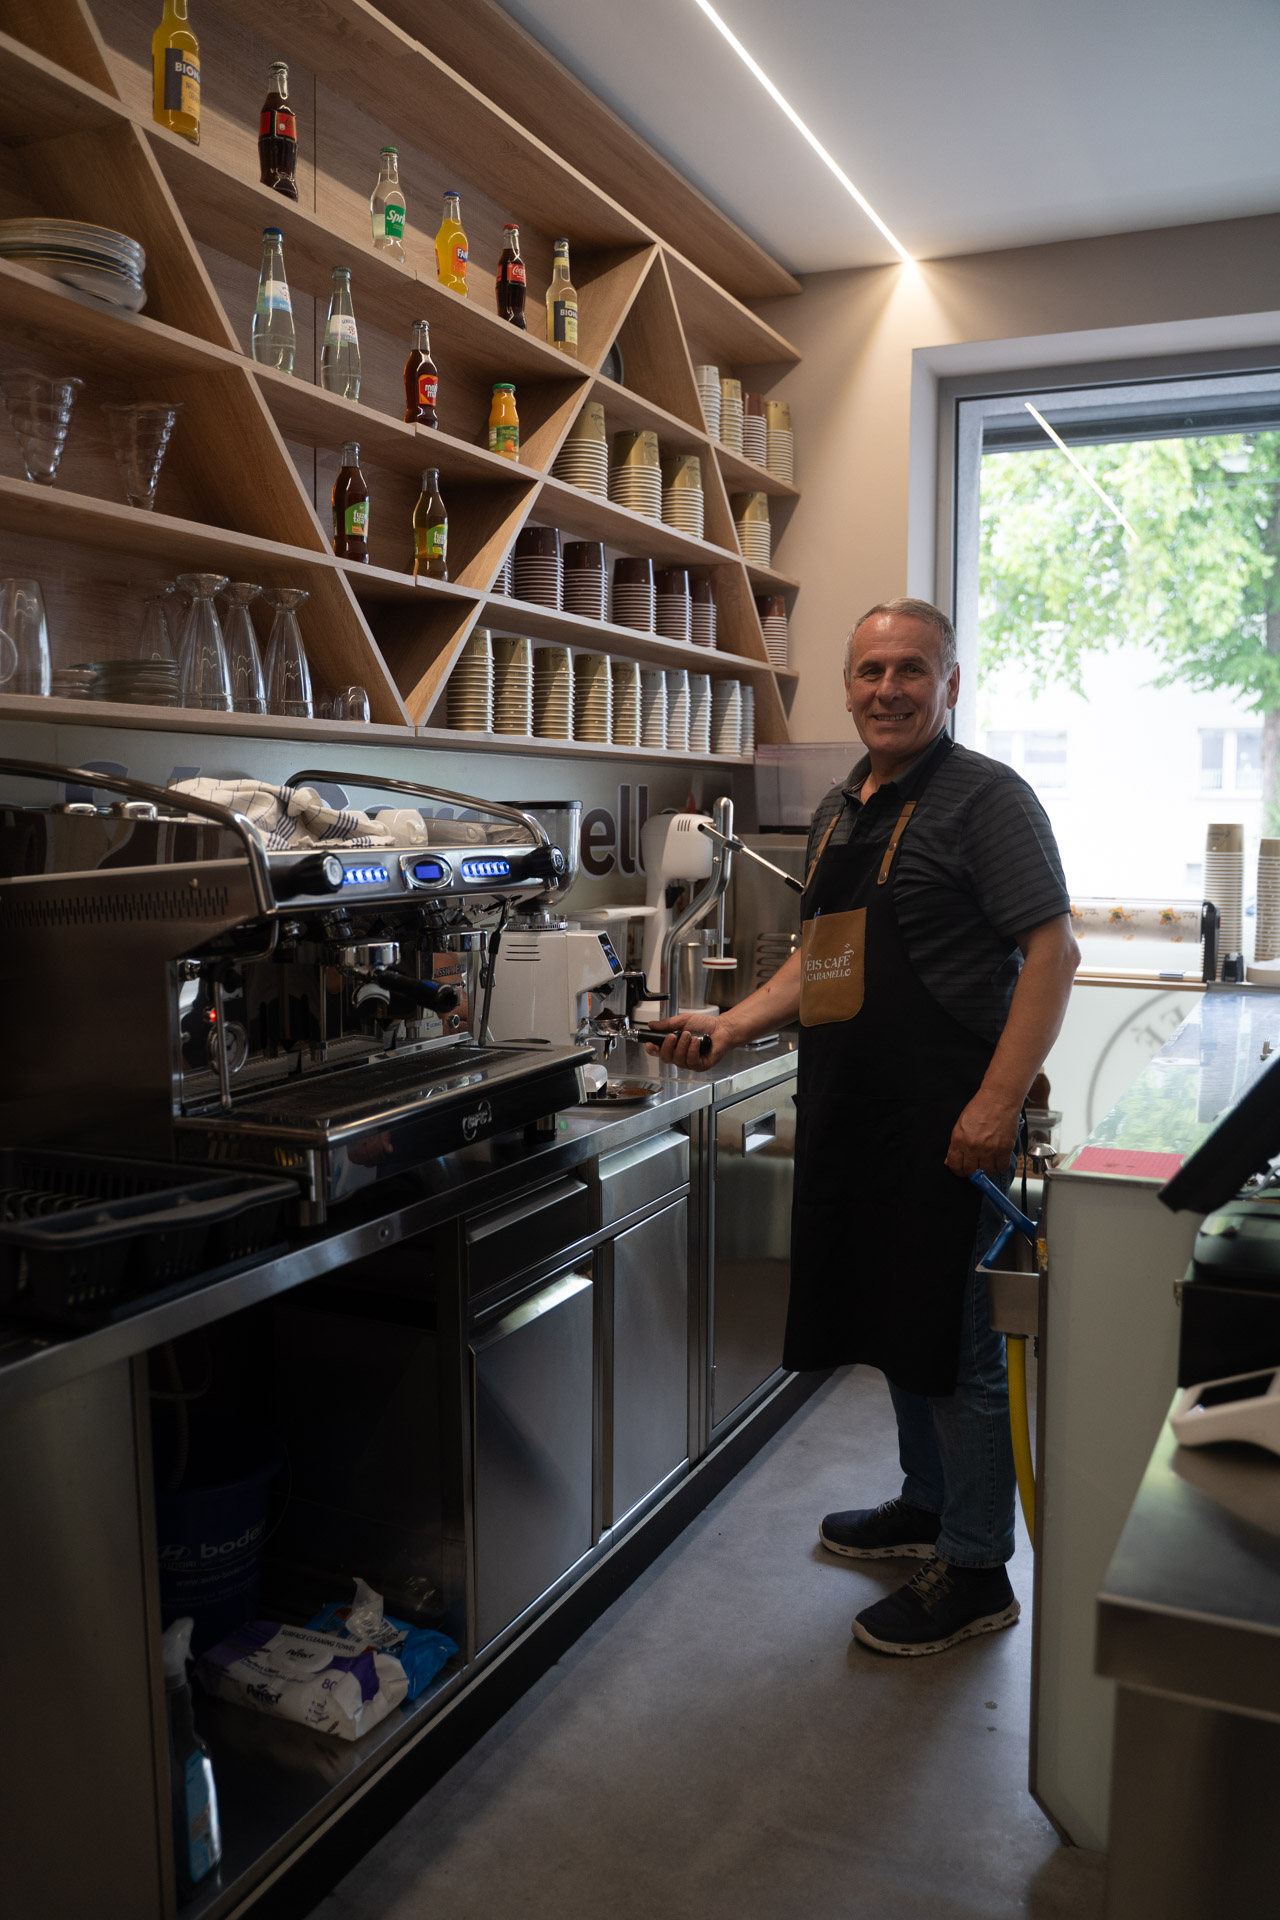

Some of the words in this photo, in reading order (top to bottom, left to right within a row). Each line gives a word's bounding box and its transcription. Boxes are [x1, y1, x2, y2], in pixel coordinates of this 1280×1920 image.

[806, 959, 822, 971] EIS
[807, 968, 851, 982] CARAMELLO
[281, 1629, 307, 1640] SURFACE
[306, 1635, 335, 1648] CLEANING
[336, 1641, 356, 1652] TOWEL
[246, 1683, 283, 1705] Perfect
